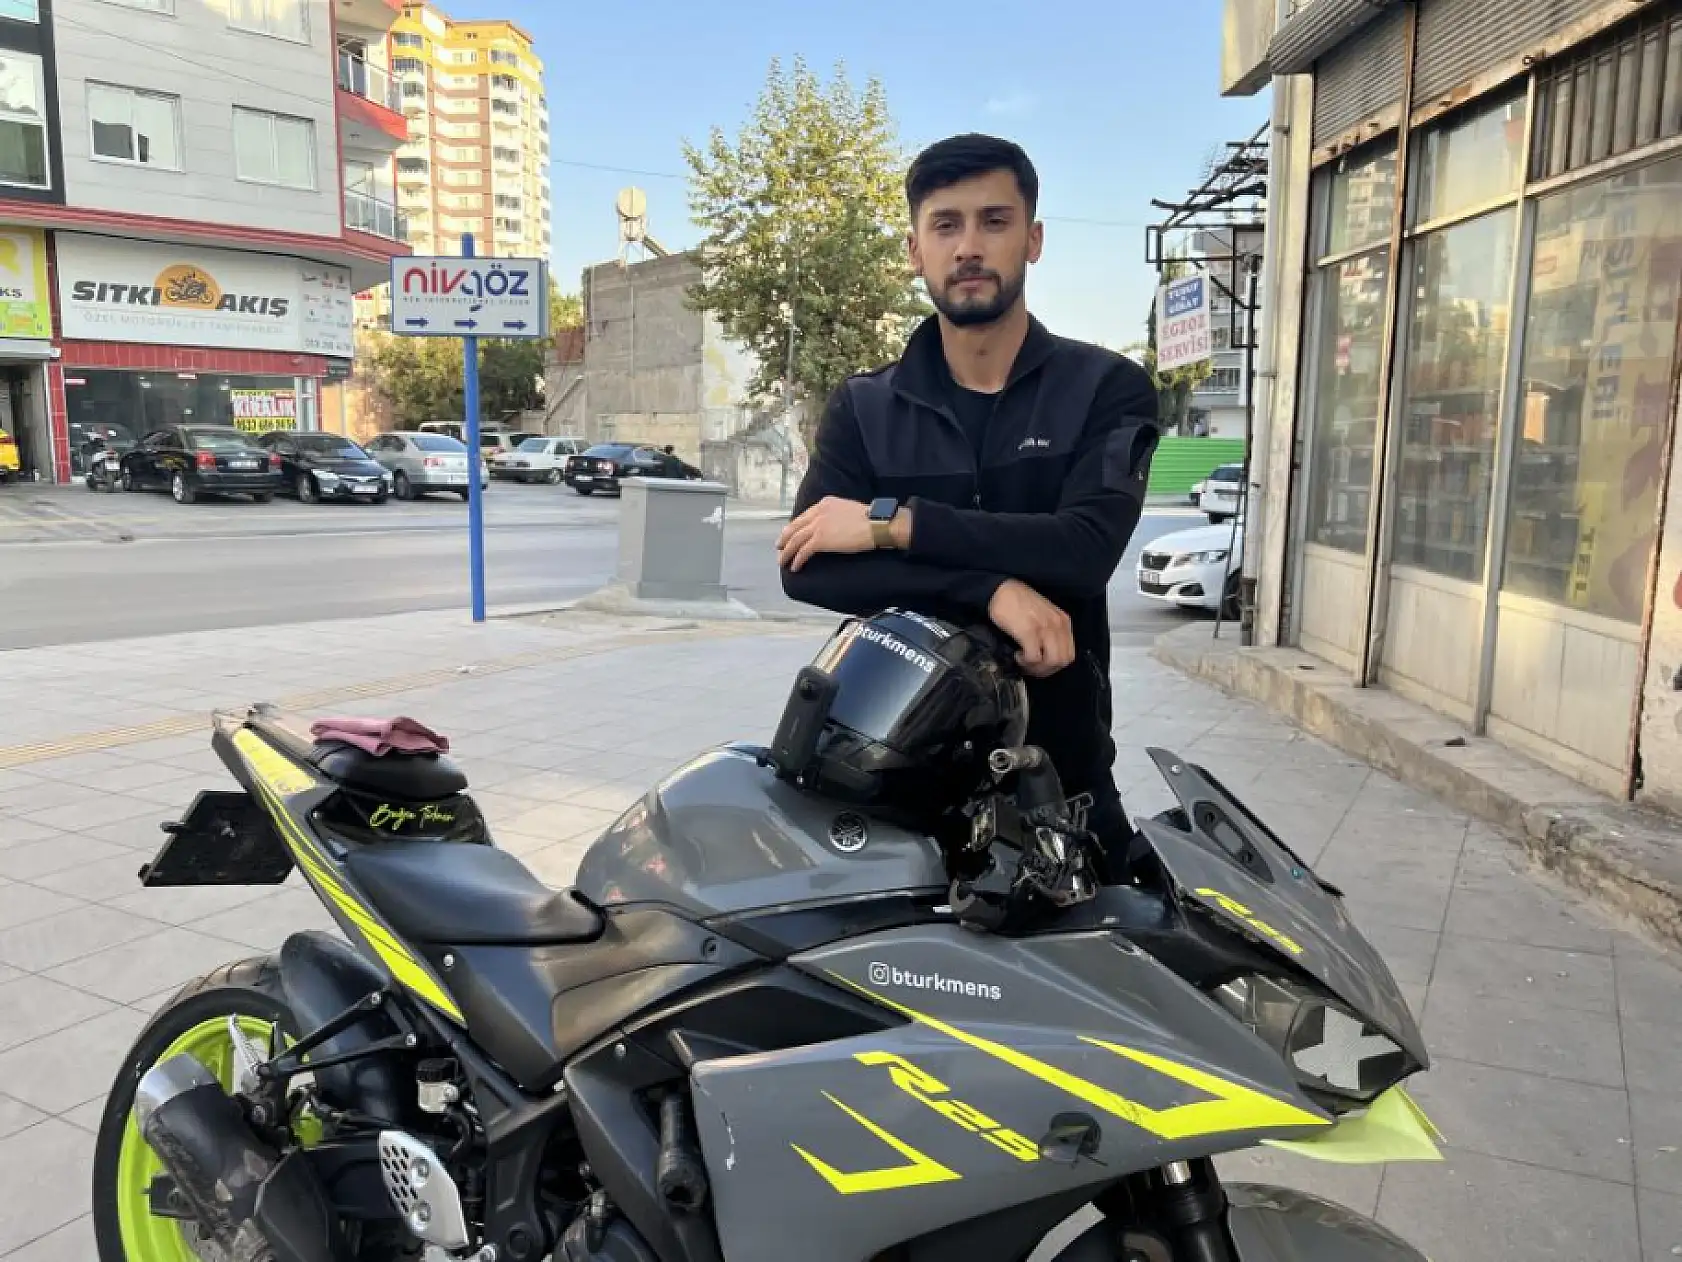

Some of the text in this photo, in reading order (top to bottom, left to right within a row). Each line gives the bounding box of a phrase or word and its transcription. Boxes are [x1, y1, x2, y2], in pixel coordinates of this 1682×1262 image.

[72, 280, 162, 306] SITKI
[215, 293, 290, 318] AKIŞ
[891, 966, 1002, 1000] bturkmens
